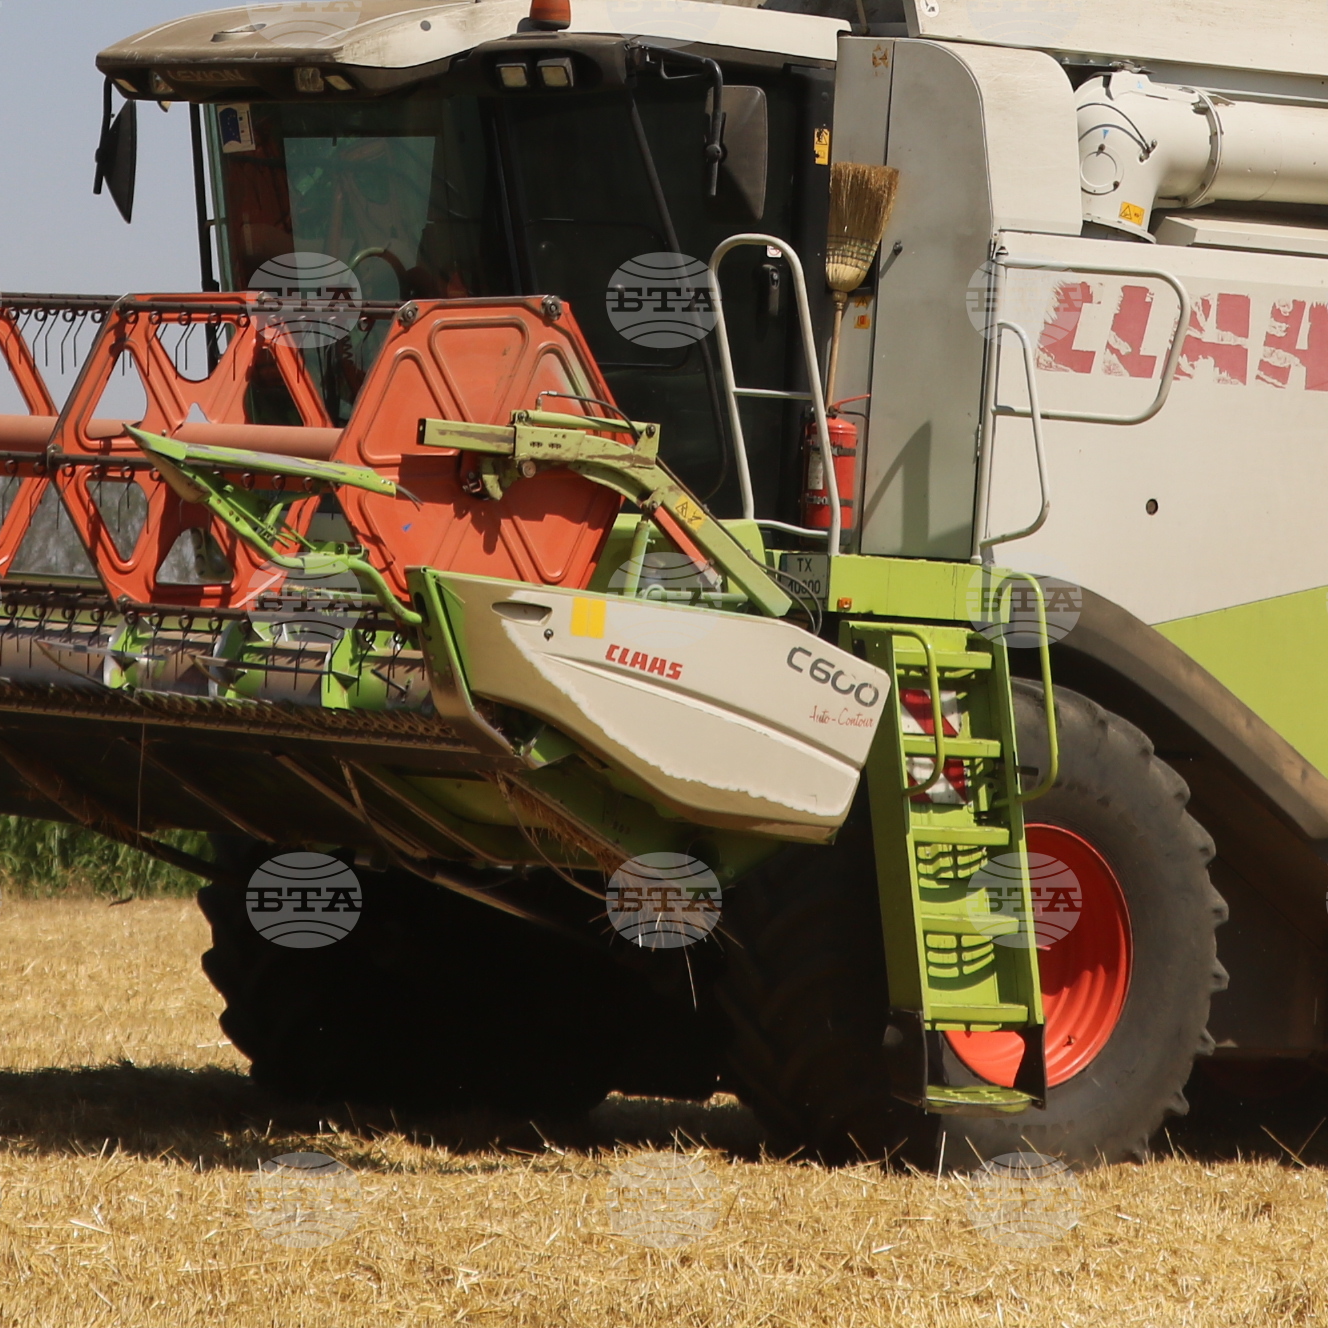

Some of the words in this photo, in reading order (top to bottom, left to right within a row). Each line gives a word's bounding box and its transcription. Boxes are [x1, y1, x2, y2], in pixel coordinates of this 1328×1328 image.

[797, 557, 812, 572] TX
[604, 643, 683, 681] CLAAS
[786, 646, 880, 708] C600
